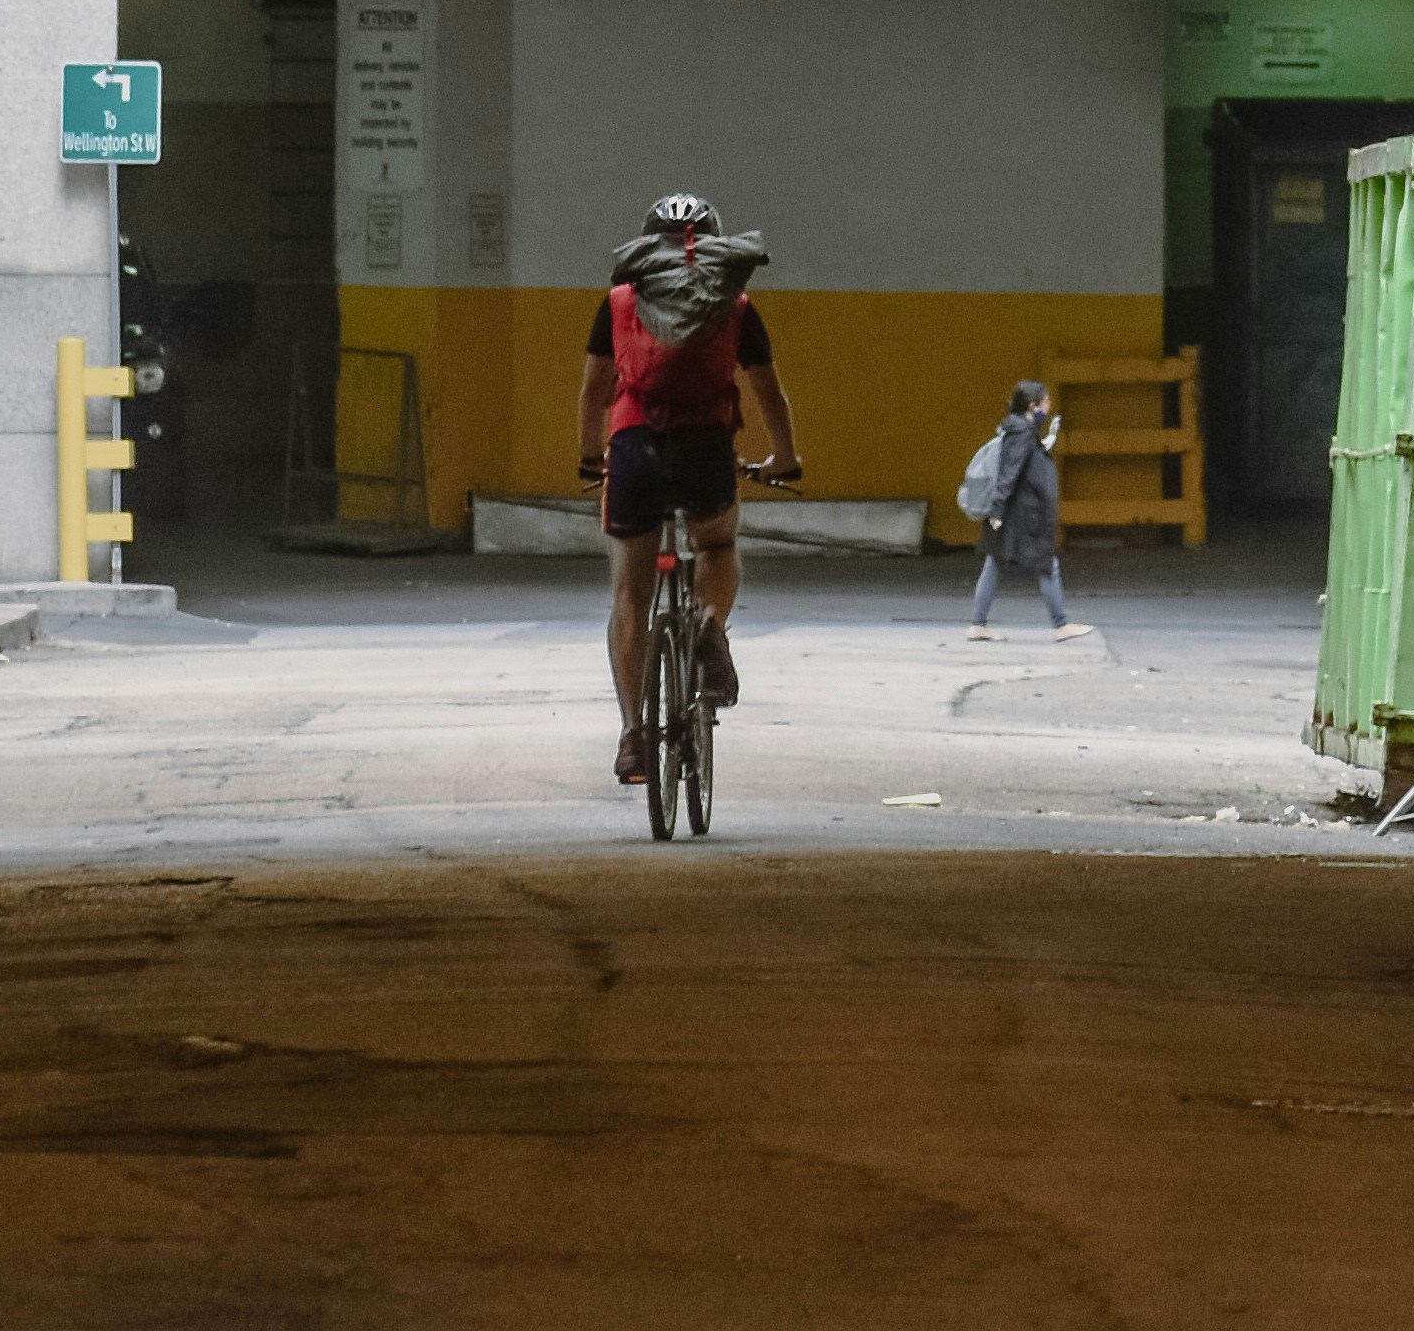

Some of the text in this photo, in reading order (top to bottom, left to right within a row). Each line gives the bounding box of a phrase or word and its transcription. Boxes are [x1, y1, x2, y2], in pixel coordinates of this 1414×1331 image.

[103, 110, 117, 130] To
[64, 132, 156, 156] Wellington St W
